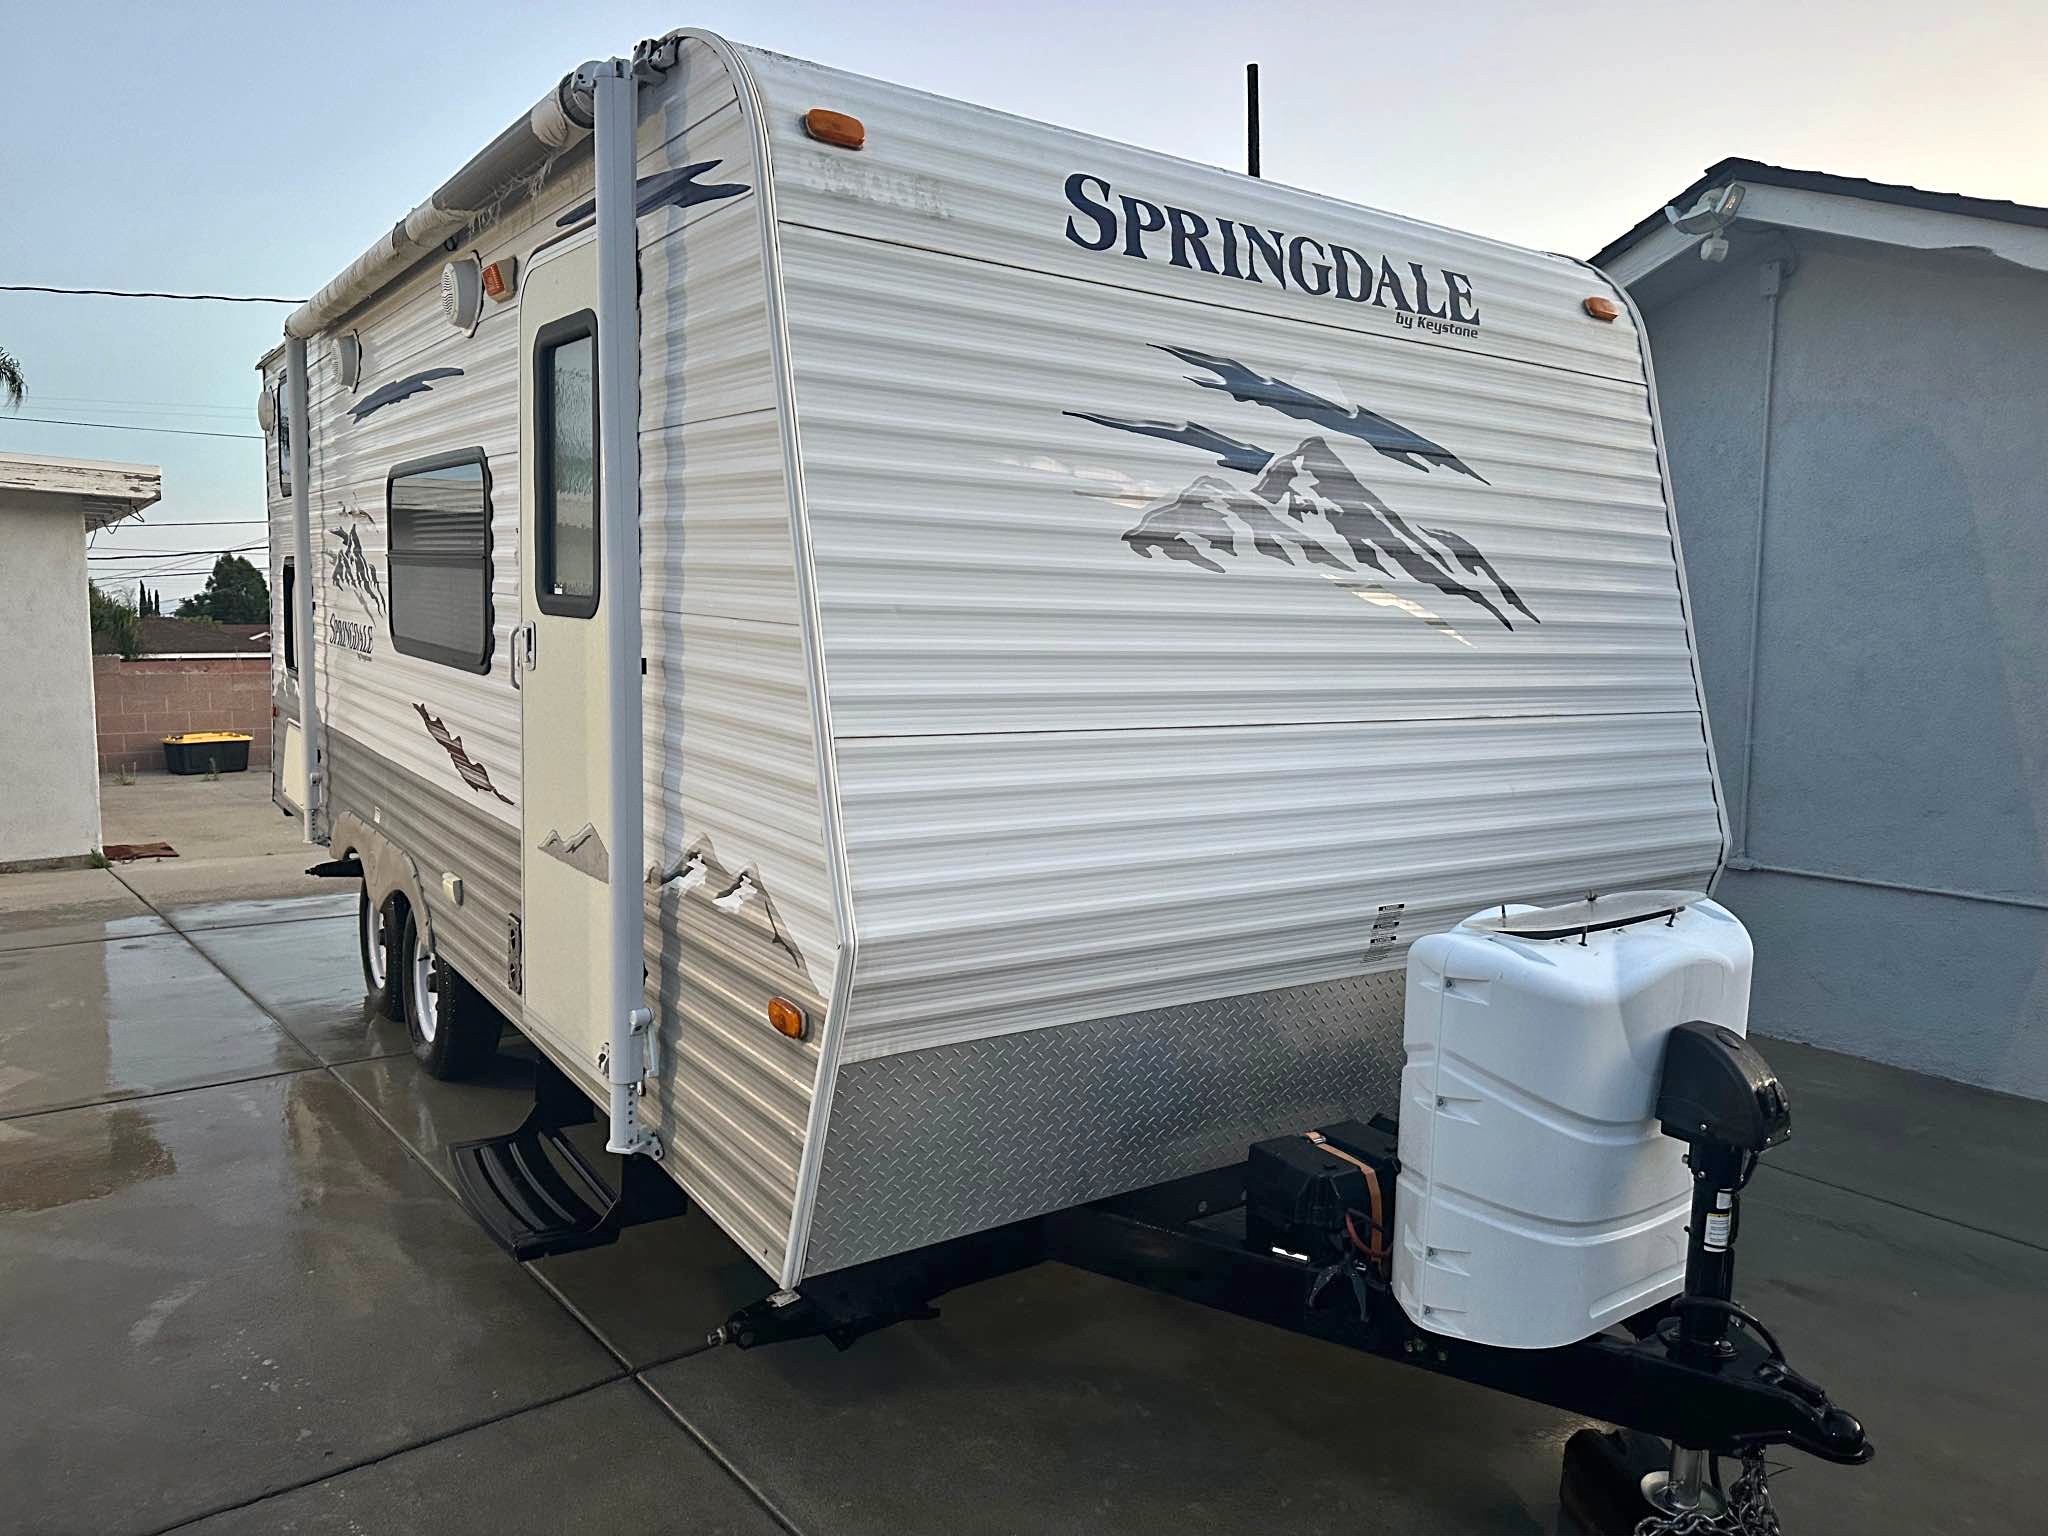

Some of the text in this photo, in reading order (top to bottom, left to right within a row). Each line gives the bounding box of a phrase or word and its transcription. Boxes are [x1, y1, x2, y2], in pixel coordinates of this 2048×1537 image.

[1064, 173, 1480, 325] SPRINGDALE
[1396, 312, 1479, 339] by Keystone
[329, 613, 374, 654] SPRINGDALE
